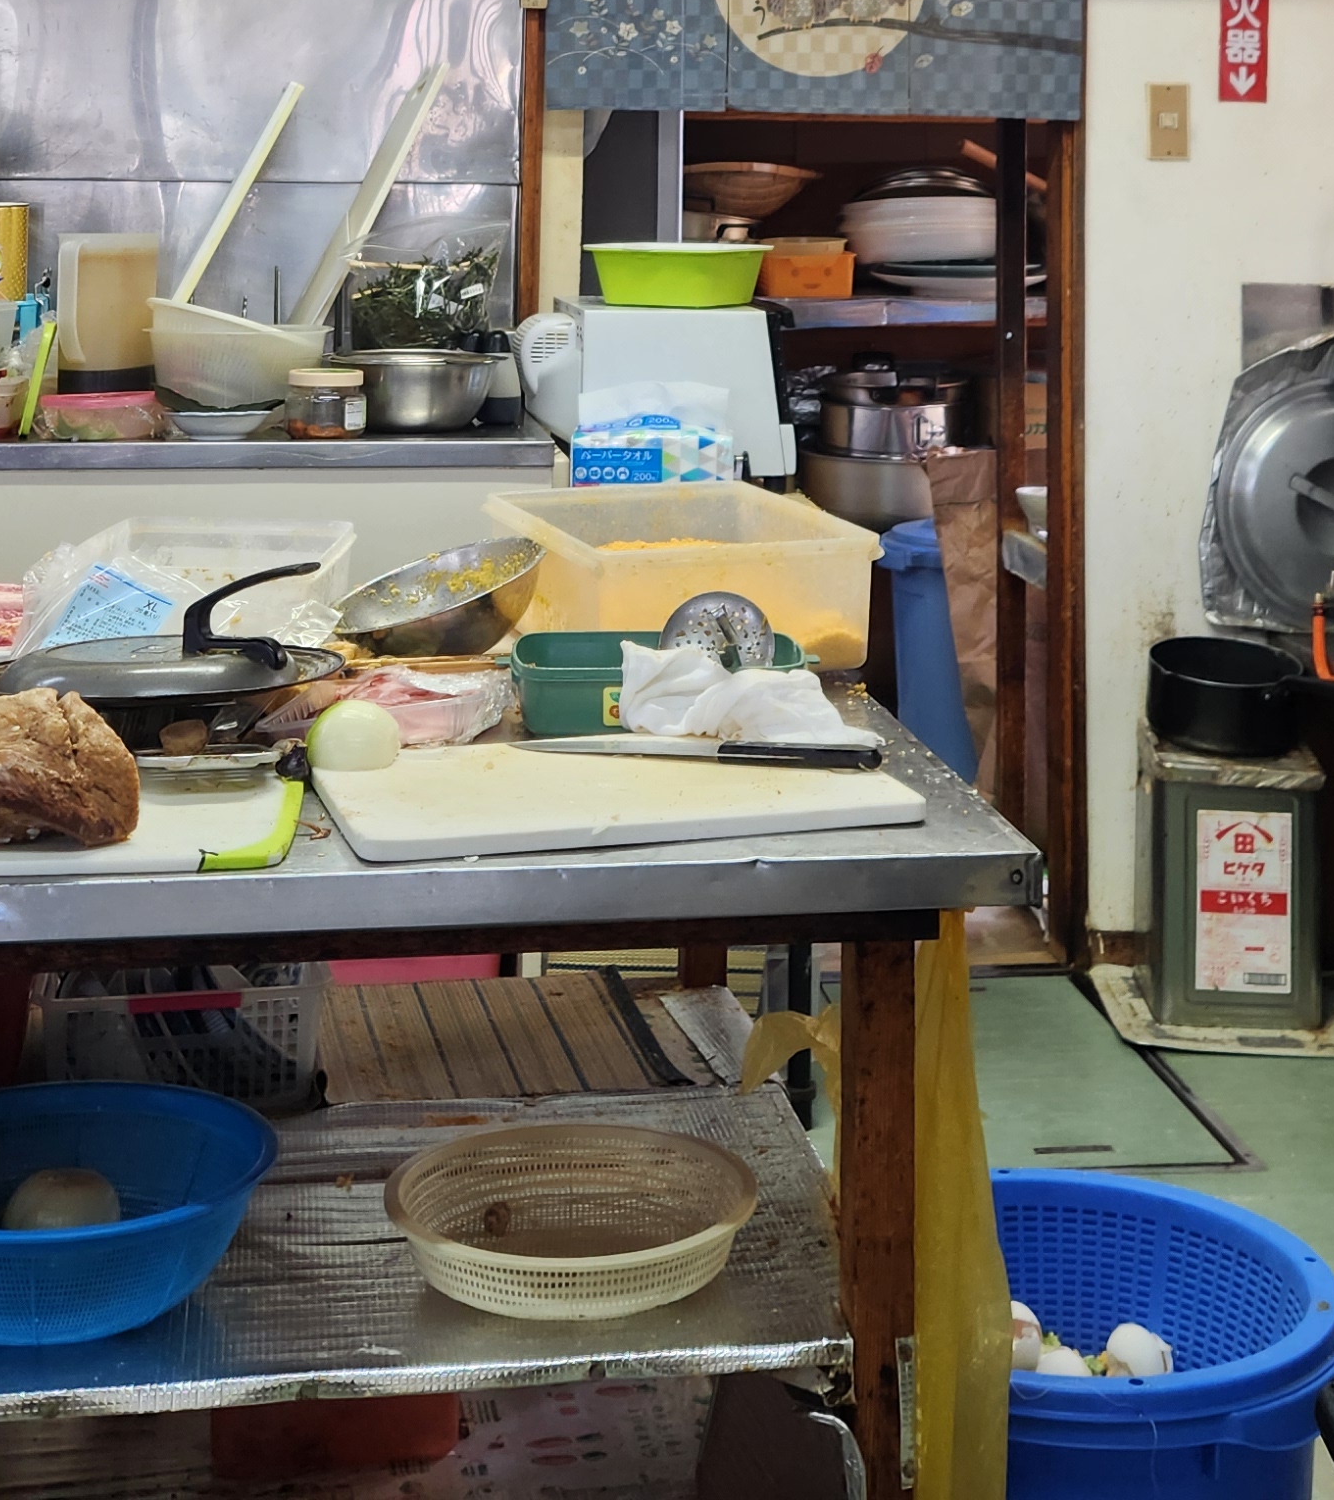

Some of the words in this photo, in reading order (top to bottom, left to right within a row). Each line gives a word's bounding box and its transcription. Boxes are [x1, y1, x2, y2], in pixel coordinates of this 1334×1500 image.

[580, 450, 653, 461] ペーパータオル
[143, 600, 158, 613] XL
[1217, 891, 1273, 908] こいくち
